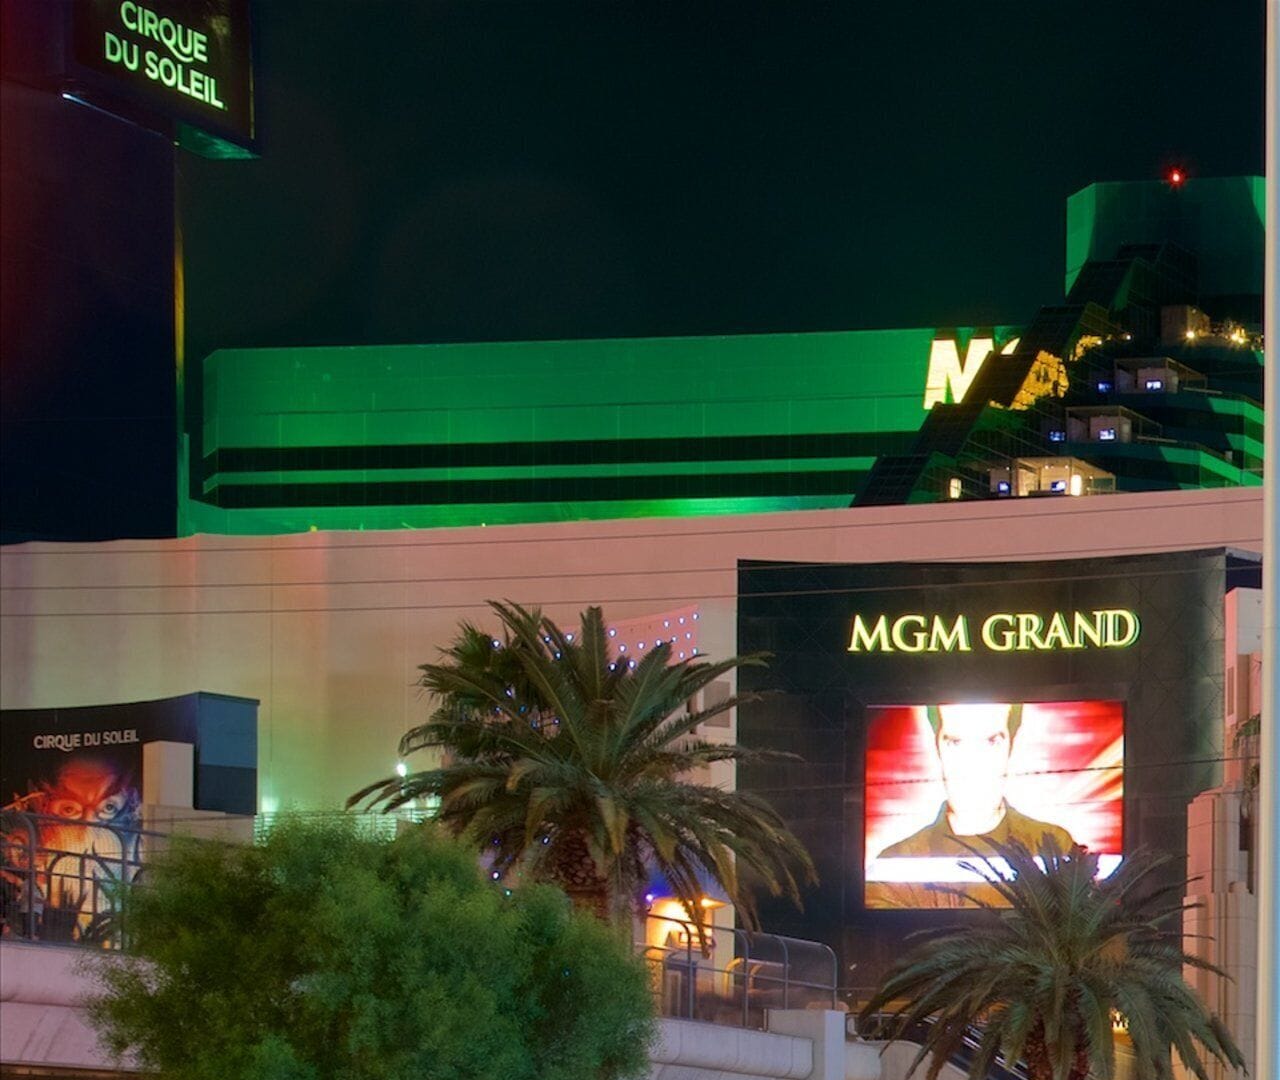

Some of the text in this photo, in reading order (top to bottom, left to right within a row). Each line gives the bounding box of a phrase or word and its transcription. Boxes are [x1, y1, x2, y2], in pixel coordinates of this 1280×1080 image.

[120, 0, 208, 63] CIRQUE
[105, 31, 224, 109] DU SOLEIL
[847, 609, 1140, 653] MGM GRAND
[33, 729, 139, 752] CIRQUE DU SOLEIL
